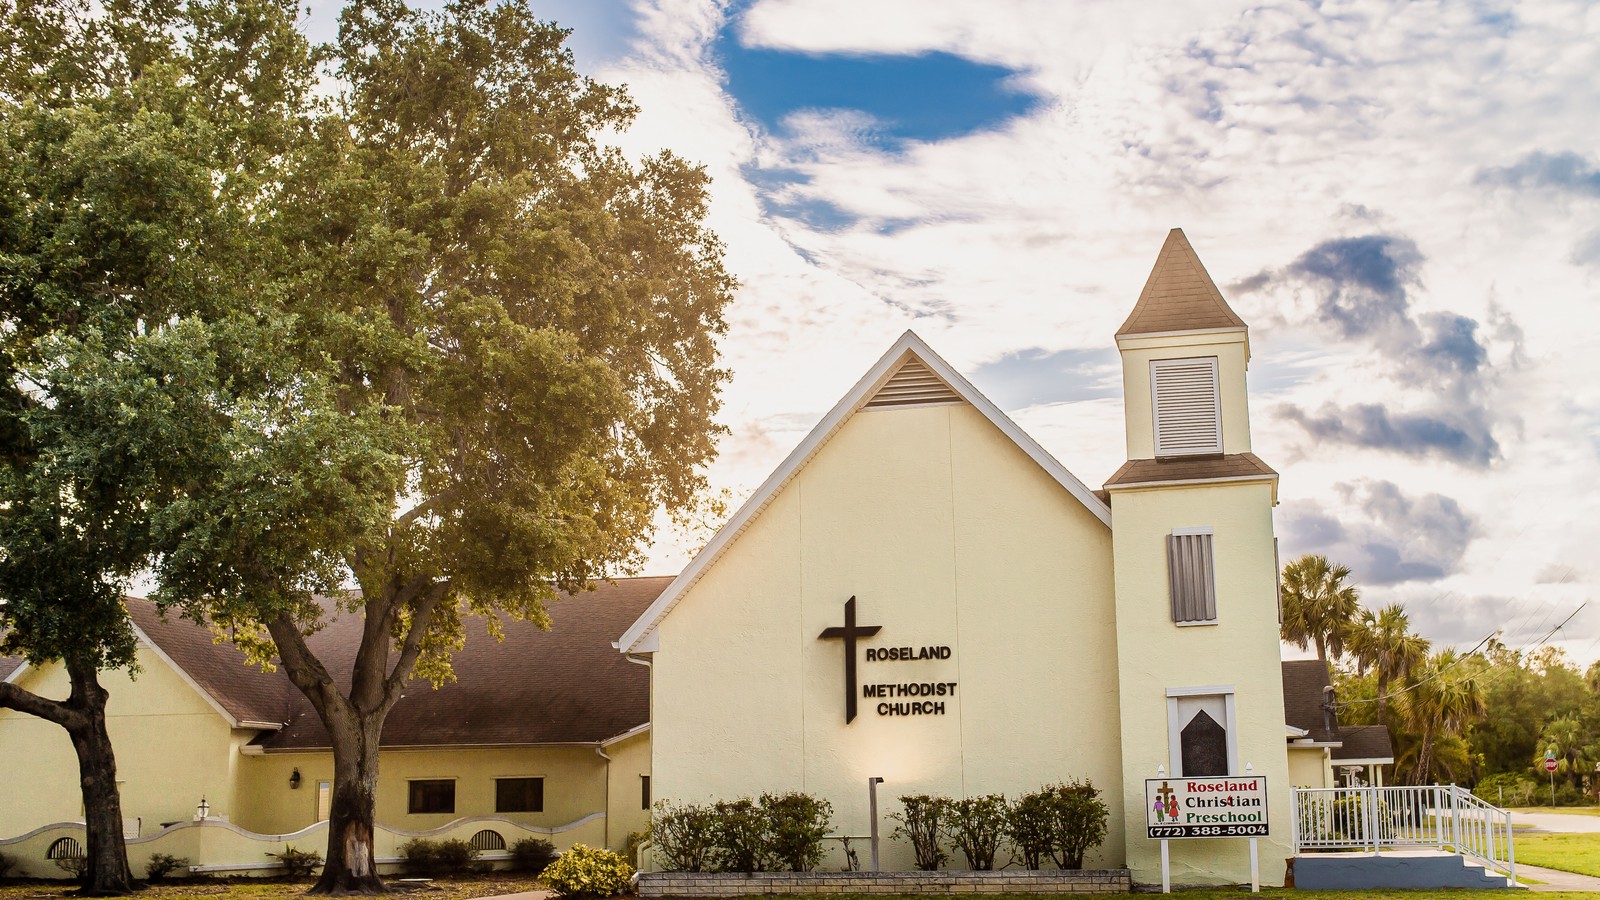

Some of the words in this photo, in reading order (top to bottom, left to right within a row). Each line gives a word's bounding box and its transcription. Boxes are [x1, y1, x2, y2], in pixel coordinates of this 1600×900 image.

[866, 646, 951, 662] ROSELAND
[863, 683, 957, 698] METHODIST
[877, 701, 945, 716] CHURCH
[1187, 780, 1258, 793] Roseland
[1185, 796, 1261, 808] Christian
[1186, 811, 1262, 823] Preschool
[1149, 826, 1186, 837] (772)
[1191, 825, 1267, 836] 388-5004
